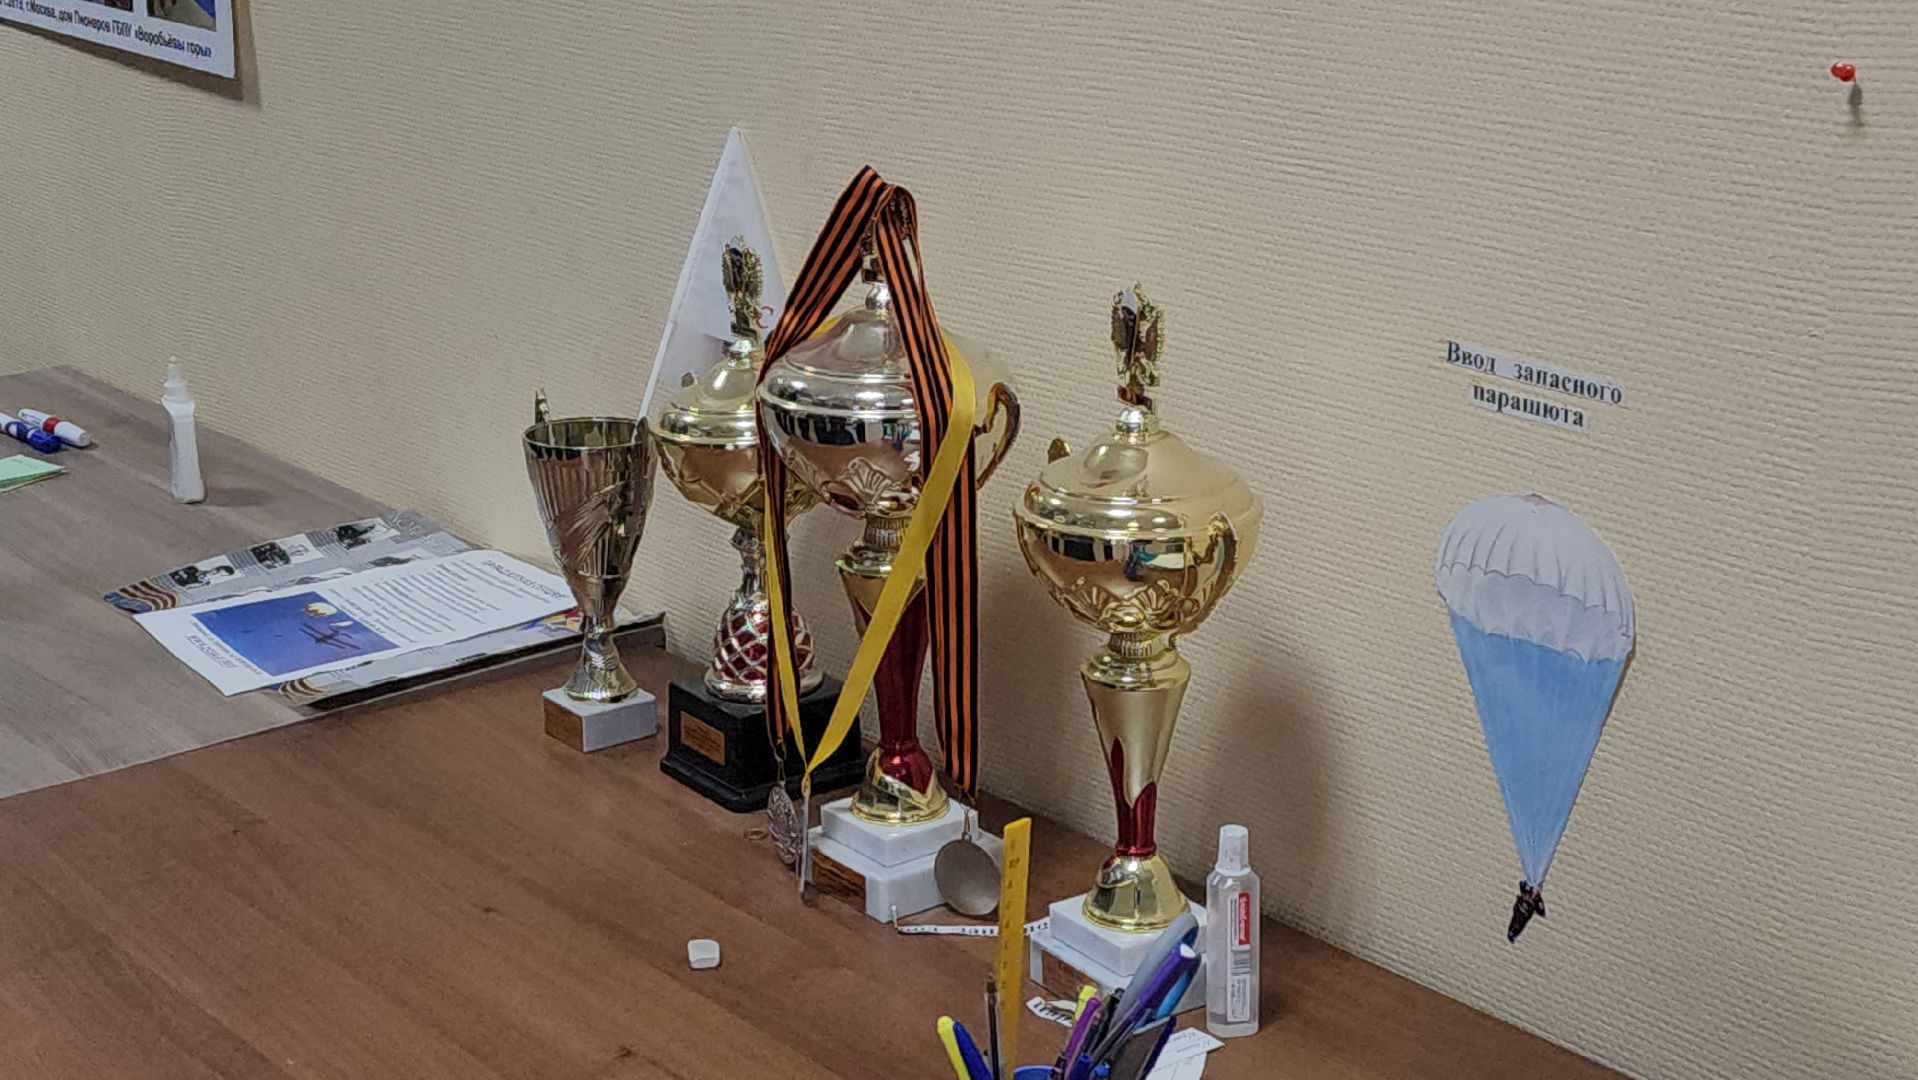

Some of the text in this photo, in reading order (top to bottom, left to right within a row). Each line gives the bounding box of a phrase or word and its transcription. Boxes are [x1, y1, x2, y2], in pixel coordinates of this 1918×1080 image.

[1446, 341, 1623, 405] Ввод запасного
[1473, 384, 1585, 428] парашюта
